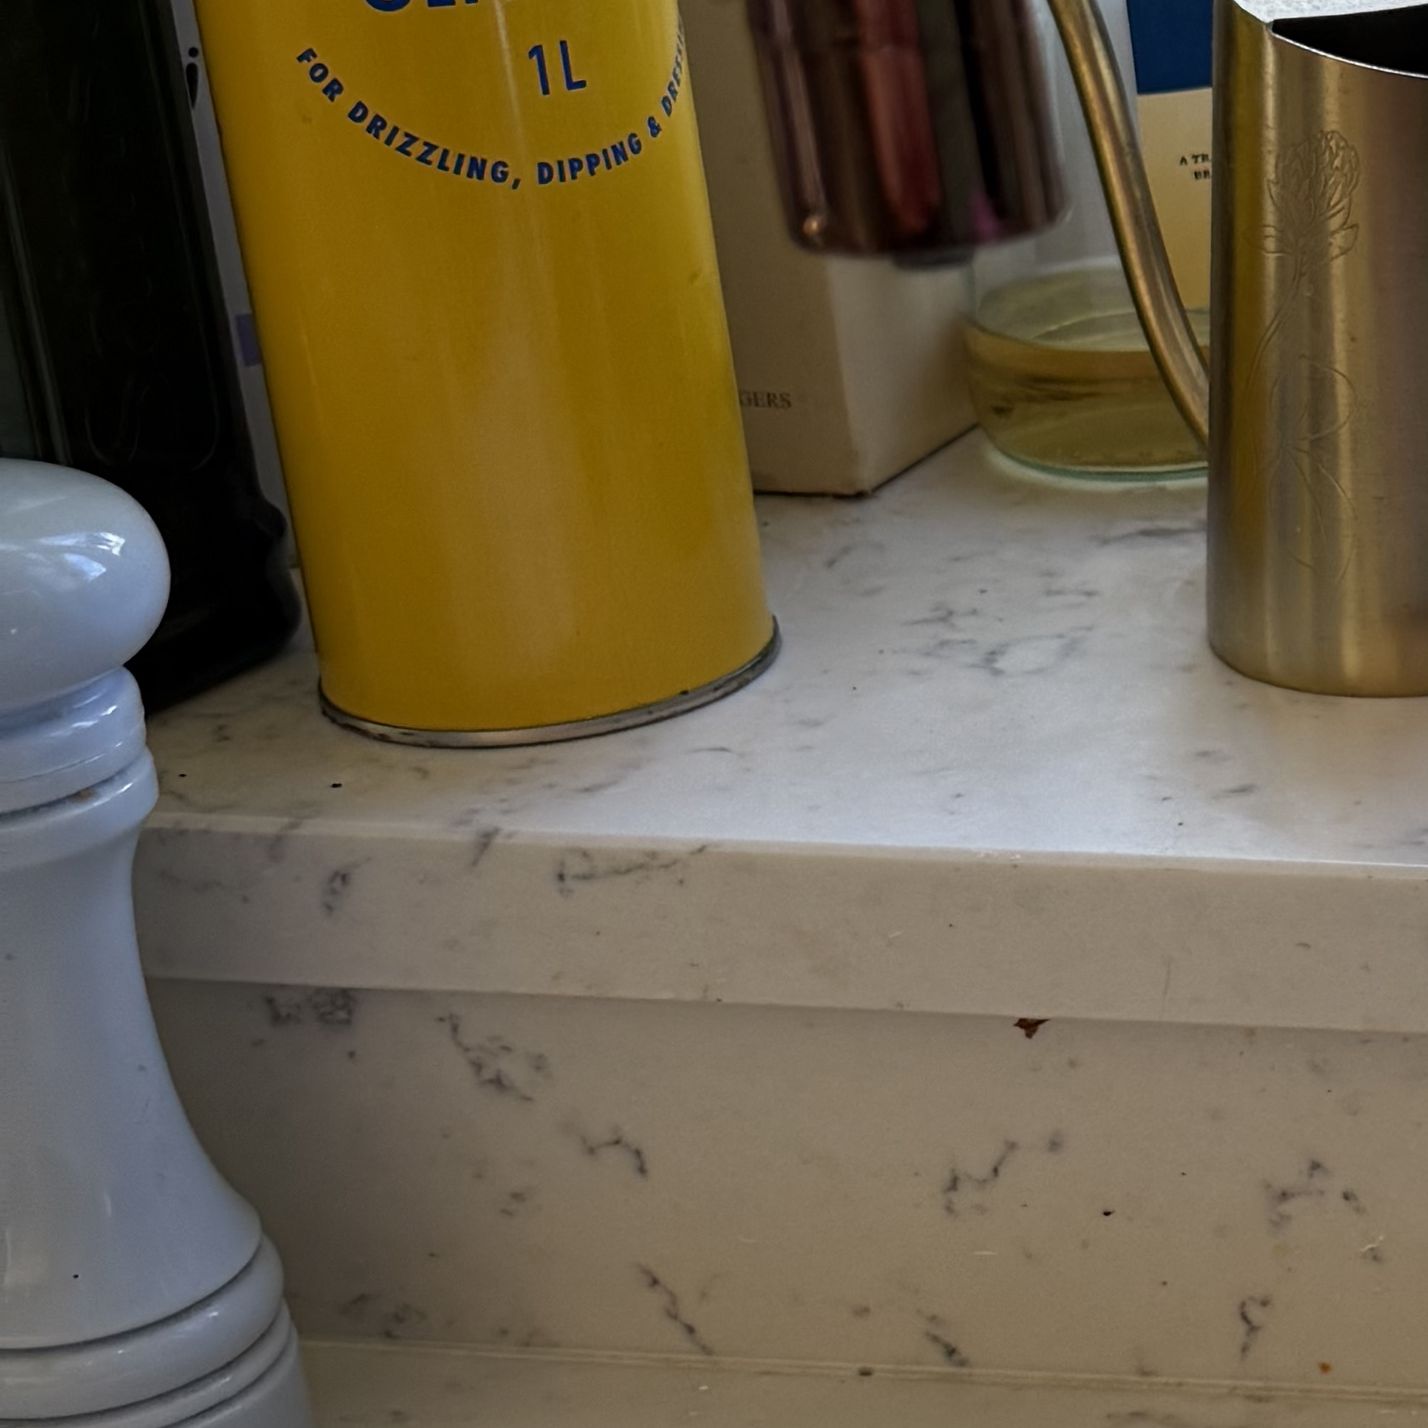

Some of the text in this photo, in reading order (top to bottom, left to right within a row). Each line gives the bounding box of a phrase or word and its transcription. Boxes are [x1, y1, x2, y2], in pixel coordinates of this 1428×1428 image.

[527, 39, 588, 96] 1L
[296, 47, 345, 102] FOR
[347, 100, 521, 190] DRIZZLING,
[536, 132, 643, 186] DIPPING
[647, 115, 663, 139] &
